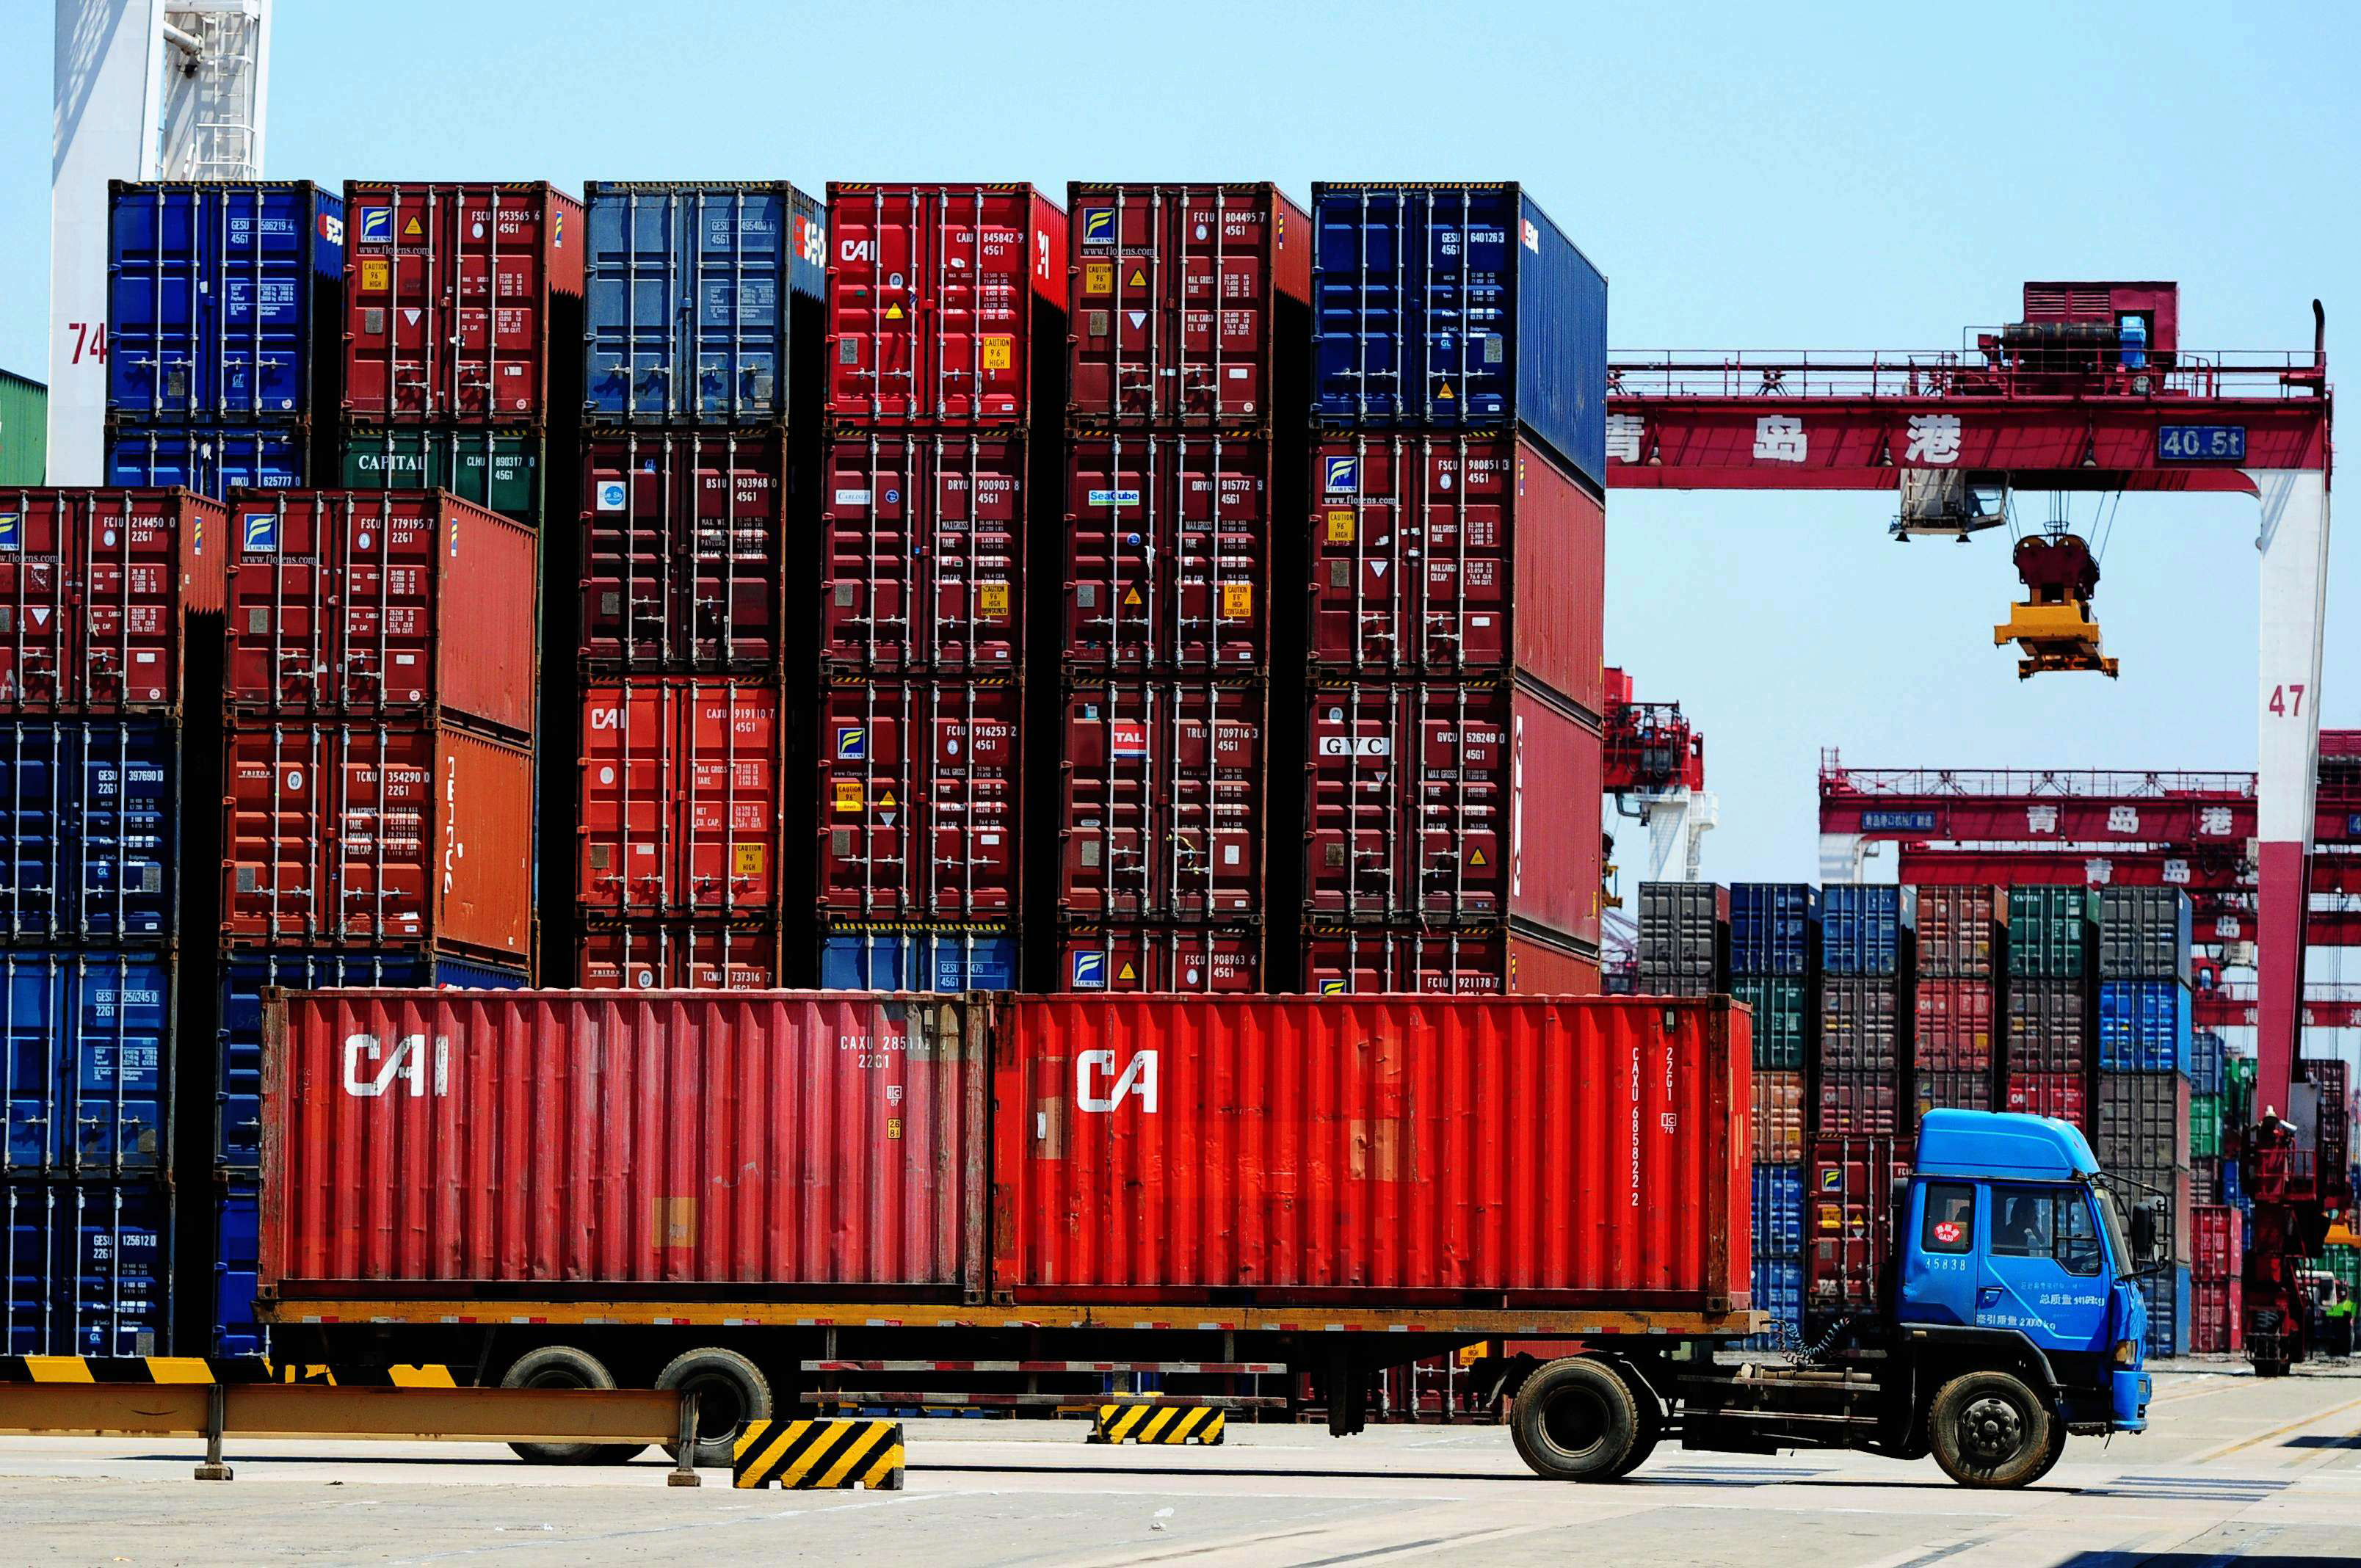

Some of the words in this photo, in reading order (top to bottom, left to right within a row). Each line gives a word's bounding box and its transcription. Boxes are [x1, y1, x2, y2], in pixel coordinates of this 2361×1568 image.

[472, 211, 490, 221] FSCU
[499, 211, 529, 221] 953565
[1194, 211, 1215, 222] FCIU
[1225, 212, 1256, 222] 804495
[231, 221, 249, 231] GESU
[498, 223, 519, 233] 45G1
[711, 221, 729, 231] GESU
[1225, 225, 1245, 236] 45G1
[231, 234, 248, 244] 45G1
[711, 235, 729, 244] 45G1
[957, 233, 973, 242] CAIU
[984, 233, 1014, 243] 845842
[1442, 232, 1460, 243] GESU
[1470, 232, 1497, 242] 640126
[359, 245, 430, 255] www.floens.com
[841, 241, 876, 261] CAI
[983, 245, 1004, 255] 45G1
[1083, 246, 1156, 256] www.floens.com
[1441, 244, 1460, 255] 45G1
[69, 323, 107, 364] 74
[2164, 430, 2240, 455] 40.5t
[358, 454, 426, 471] CAPITAL
[466, 457, 485, 466] CLHU
[496, 457, 522, 467] 890317
[1438, 460, 1457, 470] FSCU
[1468, 460, 1499, 470] 980851
[496, 471, 513, 480] 45G1
[1468, 473, 1489, 483] 45G1
[231, 476, 249, 487] INKU
[264, 476, 292, 487] 625777
[706, 478, 727, 488] BSIU
[736, 478, 768, 488] 903968
[948, 480, 968, 490] DRYU
[978, 480, 1009, 490] 900903
[1192, 481, 1212, 490] DRYU
[1222, 481, 1250, 490] 915772
[736, 492, 757, 501] 45G1
[978, 493, 998, 503] 45G1
[1090, 491, 1138, 501] SeaCube
[1222, 494, 1240, 504] 45G1
[1324, 496, 1396, 505] www.floens.com
[104, 517, 124, 527] FCIU
[132, 517, 164, 527] 214450
[360, 518, 381, 529] FSCU
[392, 518, 424, 529] 779195
[132, 531, 153, 542] 22G1
[392, 532, 413, 543] 22G1
[242, 554, 317, 565] www.floens.com
[2268, 684, 2304, 717] 47
[591, 708, 625, 729] CAI
[707, 709, 726, 719] CAXU
[734, 709, 766, 719] 919110
[736, 722, 755, 733] 45G1
[946, 726, 965, 736] FCIU
[975, 726, 1007, 736] 916253
[1114, 732, 1144, 743] TAL
[1186, 728, 1208, 738] TRLU
[1218, 728, 1250, 738] 709716
[1437, 732, 1458, 743] GVCU
[1466, 733, 1495, 744] 526249
[975, 740, 995, 750] 45G1
[1218, 741, 1238, 751] 45G1
[1465, 749, 1485, 761] 45G1
[98, 771, 117, 781] GESU
[128, 771, 156, 781] 397690
[356, 772, 377, 783] TCKU
[388, 772, 421, 783] 354290
[98, 783, 117, 794] 22G1
[388, 785, 410, 796] 22G1
[2026, 805, 2233, 835] 青岛港
[1185, 955, 1205, 965] FSCU
[1214, 955, 1245, 965] 908963
[941, 963, 960, 973] GESU
[1214, 968, 1234, 978] 45G1
[702, 971, 722, 981] TCNU
[732, 972, 760, 982] 737316
[941, 977, 959, 987] 45G1
[1427, 978, 1448, 988] FCIU
[1459, 978, 1490, 988] 921178
[95, 992, 115, 1003] GESU
[123, 992, 150, 1003] 250245
[95, 1006, 115, 1017] 22G1
[841, 1036, 873, 1050] CAXU
[344, 1034, 449, 1097] CAI
[858, 1054, 890, 1068] 22G1
[1631, 1047, 1639, 1101] CAXU
[891, 1099, 899, 1107] 87
[1631, 1106, 1639, 1188] 685822
[94, 1235, 112, 1246] GESU
[123, 1235, 149, 1246] 125612
[94, 1249, 112, 1259] 22G1
[2039, 1293, 2072, 1305] 总质量
